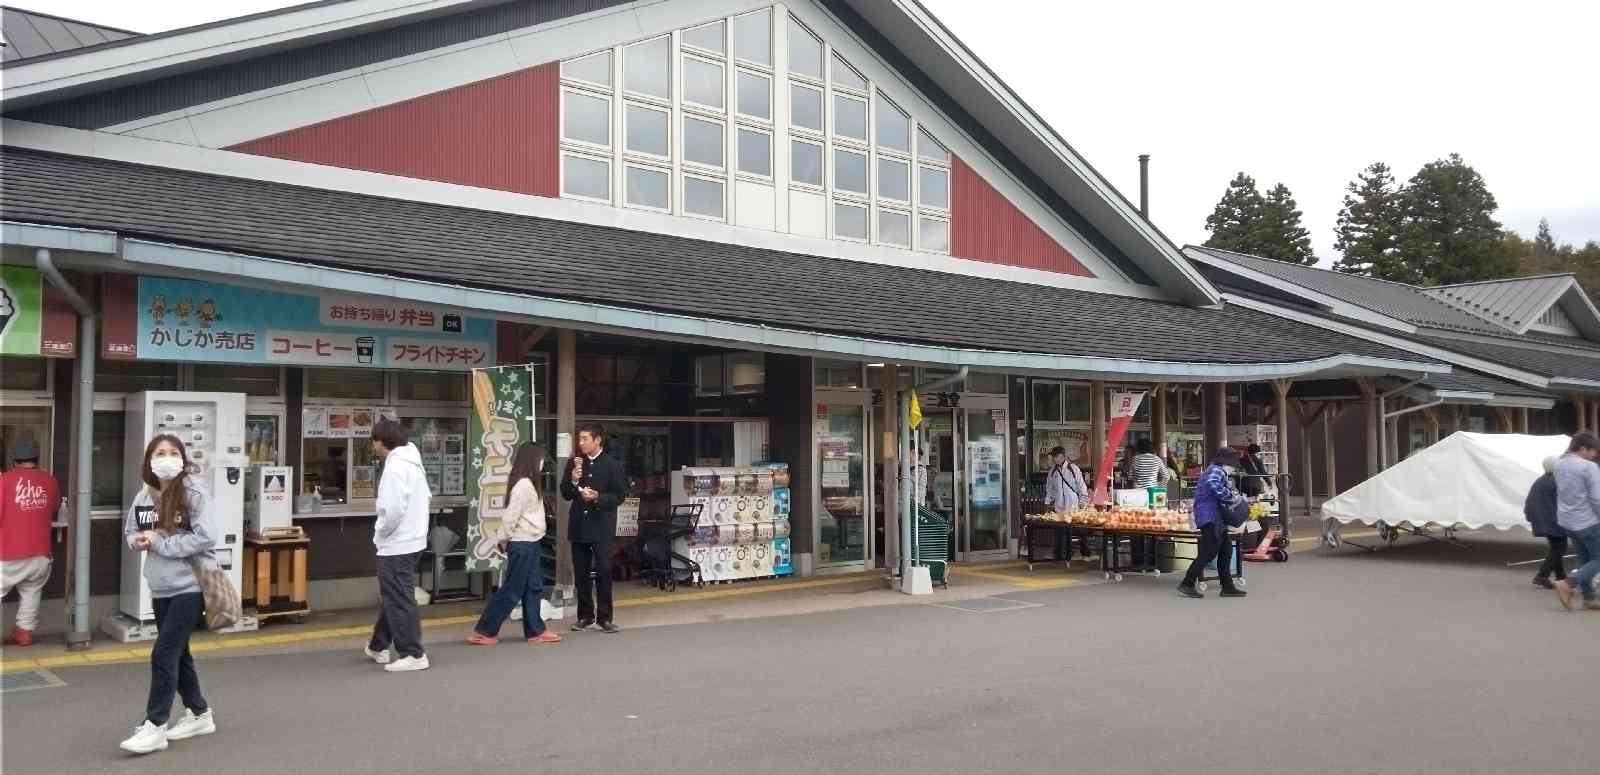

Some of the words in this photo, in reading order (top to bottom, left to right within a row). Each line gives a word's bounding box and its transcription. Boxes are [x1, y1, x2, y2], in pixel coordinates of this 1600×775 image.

[150, 327, 256, 350] かじか売店
[273, 337, 352, 357] コーヒー
[393, 343, 486, 364] フライドチキン
